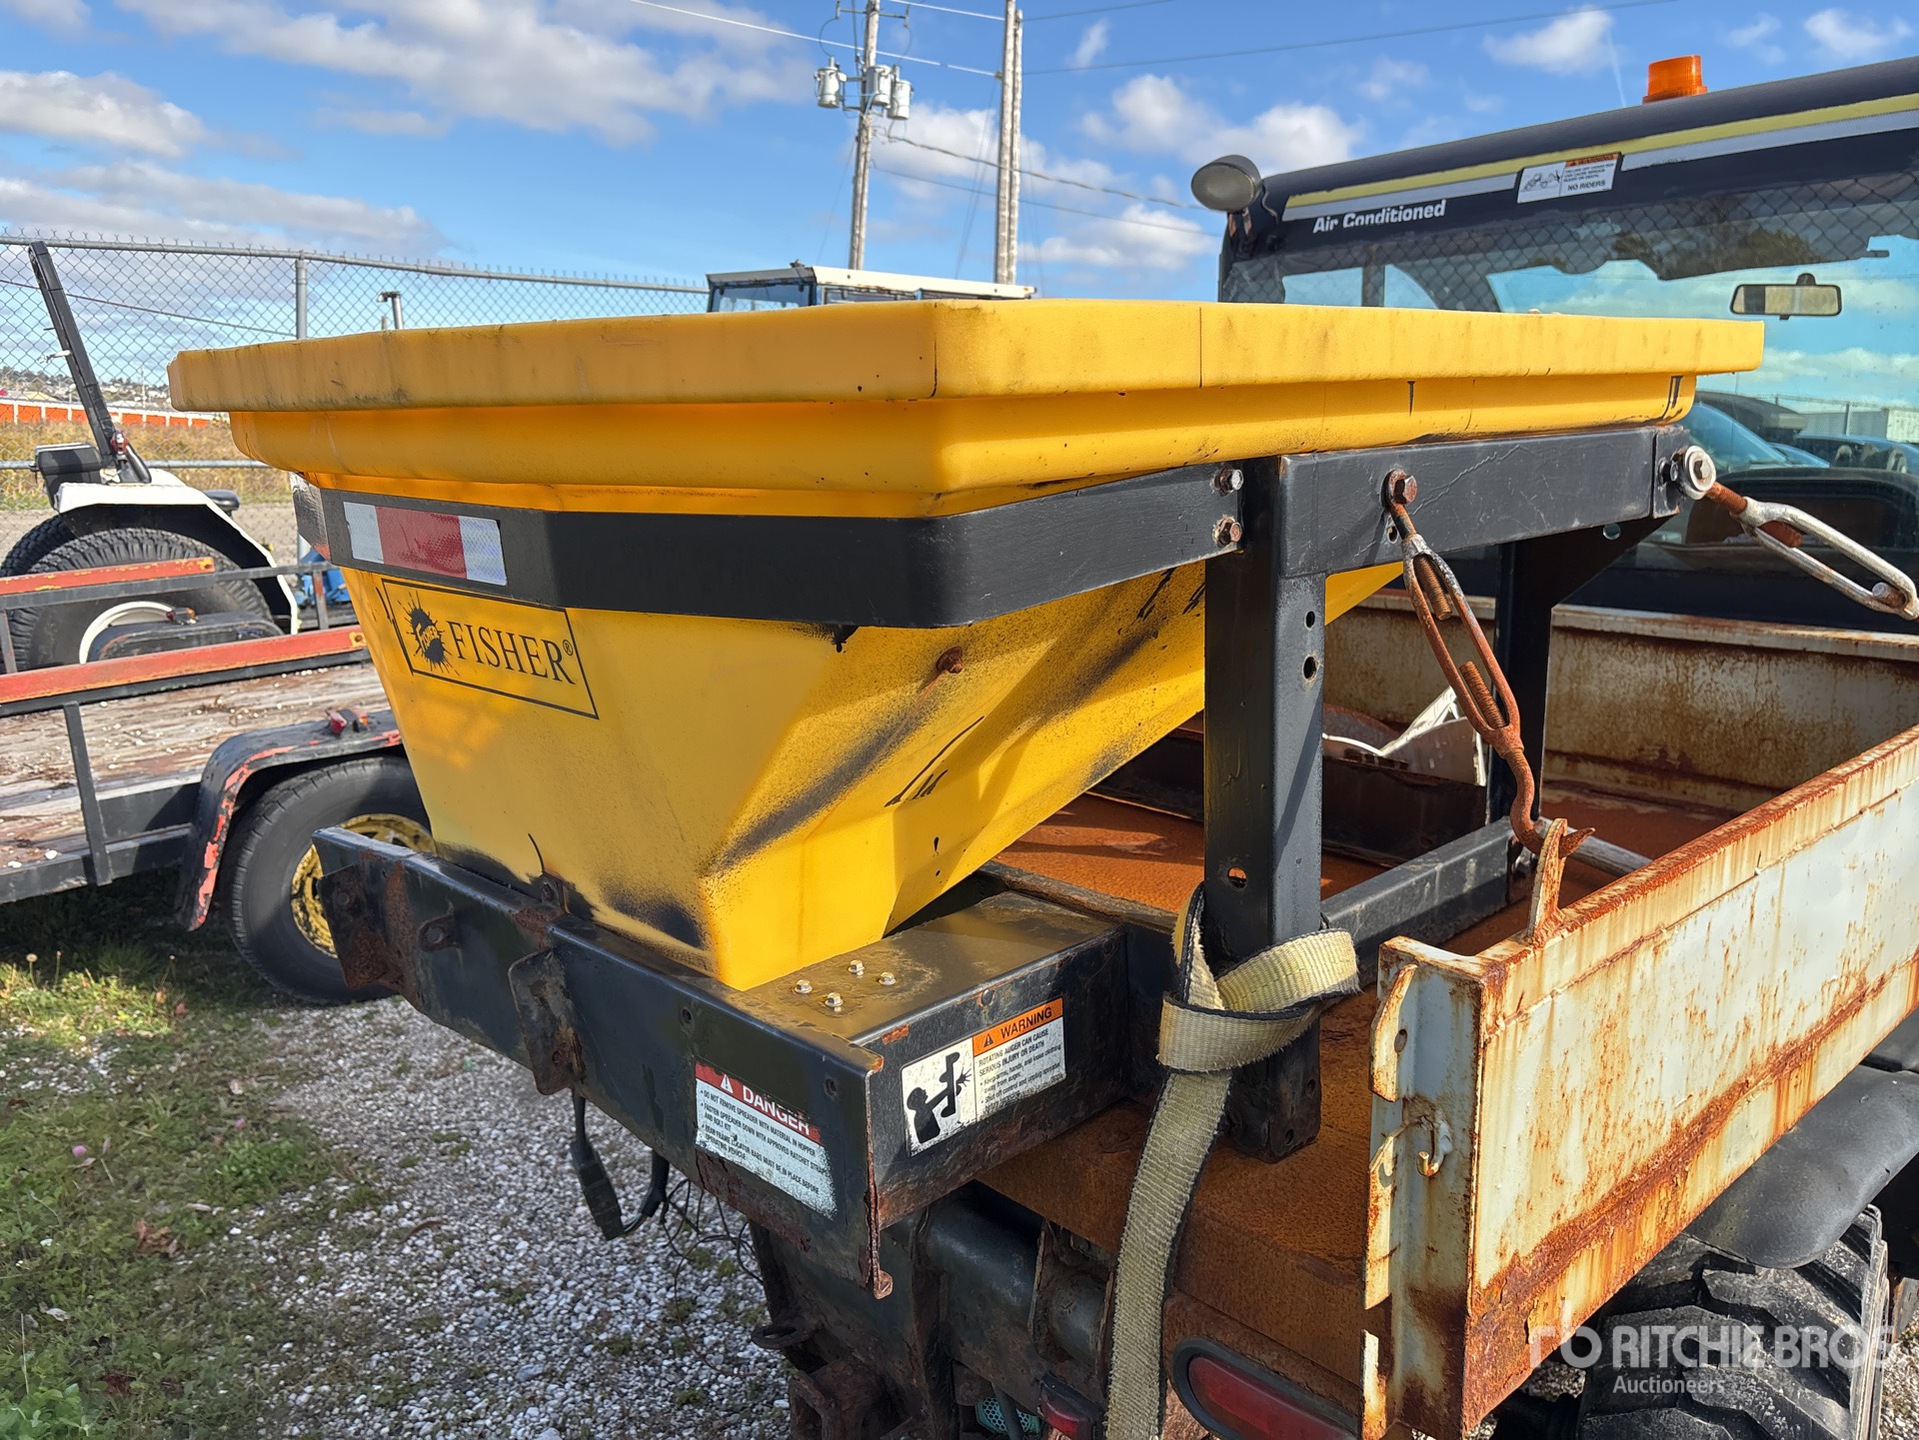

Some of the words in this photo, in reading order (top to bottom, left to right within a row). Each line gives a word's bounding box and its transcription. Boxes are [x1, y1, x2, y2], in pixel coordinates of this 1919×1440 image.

[1567, 182, 1579, 191] NO
[1580, 180, 1606, 190] RIDERS
[1312, 216, 1338, 234] Air
[1342, 199, 1446, 228] Conditioned
[1000, 1007, 1052, 1038] WARNING
[979, 1050, 1003, 1067] ROTATING
[1005, 1042, 1021, 1054] AUGER
[1022, 1036, 1032, 1046] CAN
[1032, 1028, 1049, 1041] CAUSE
[980, 1061, 1001, 1076] SERIOUS
[1002, 1052, 1020, 1066] INJURY
[1020, 1048, 1028, 1057] OR
[1028, 1040, 1044, 1053] DEATH
[704, 1112, 713, 1121] AND
[714, 1116, 724, 1128] BOLT
[711, 1094, 719, 1103] NOT
[720, 1098, 736, 1112] REMOVE
[736, 1108, 758, 1124] SPREADER
[759, 1120, 769, 1131] WITH
[770, 1126, 792, 1144] MATERIAL
[798, 1141, 816, 1157] HOPPER
[742, 1085, 810, 1136] DANGER
[720, 1111, 742, 1127] SPREADER
[756, 1130, 766, 1142] WITH
[767, 1137, 790, 1155] APPROVED
[790, 1150, 810, 1166] RATCHET
[762, 1156, 774, 1168] MUST
[776, 1163, 782, 1172] BE
[788, 1170, 802, 1185] PLACE
